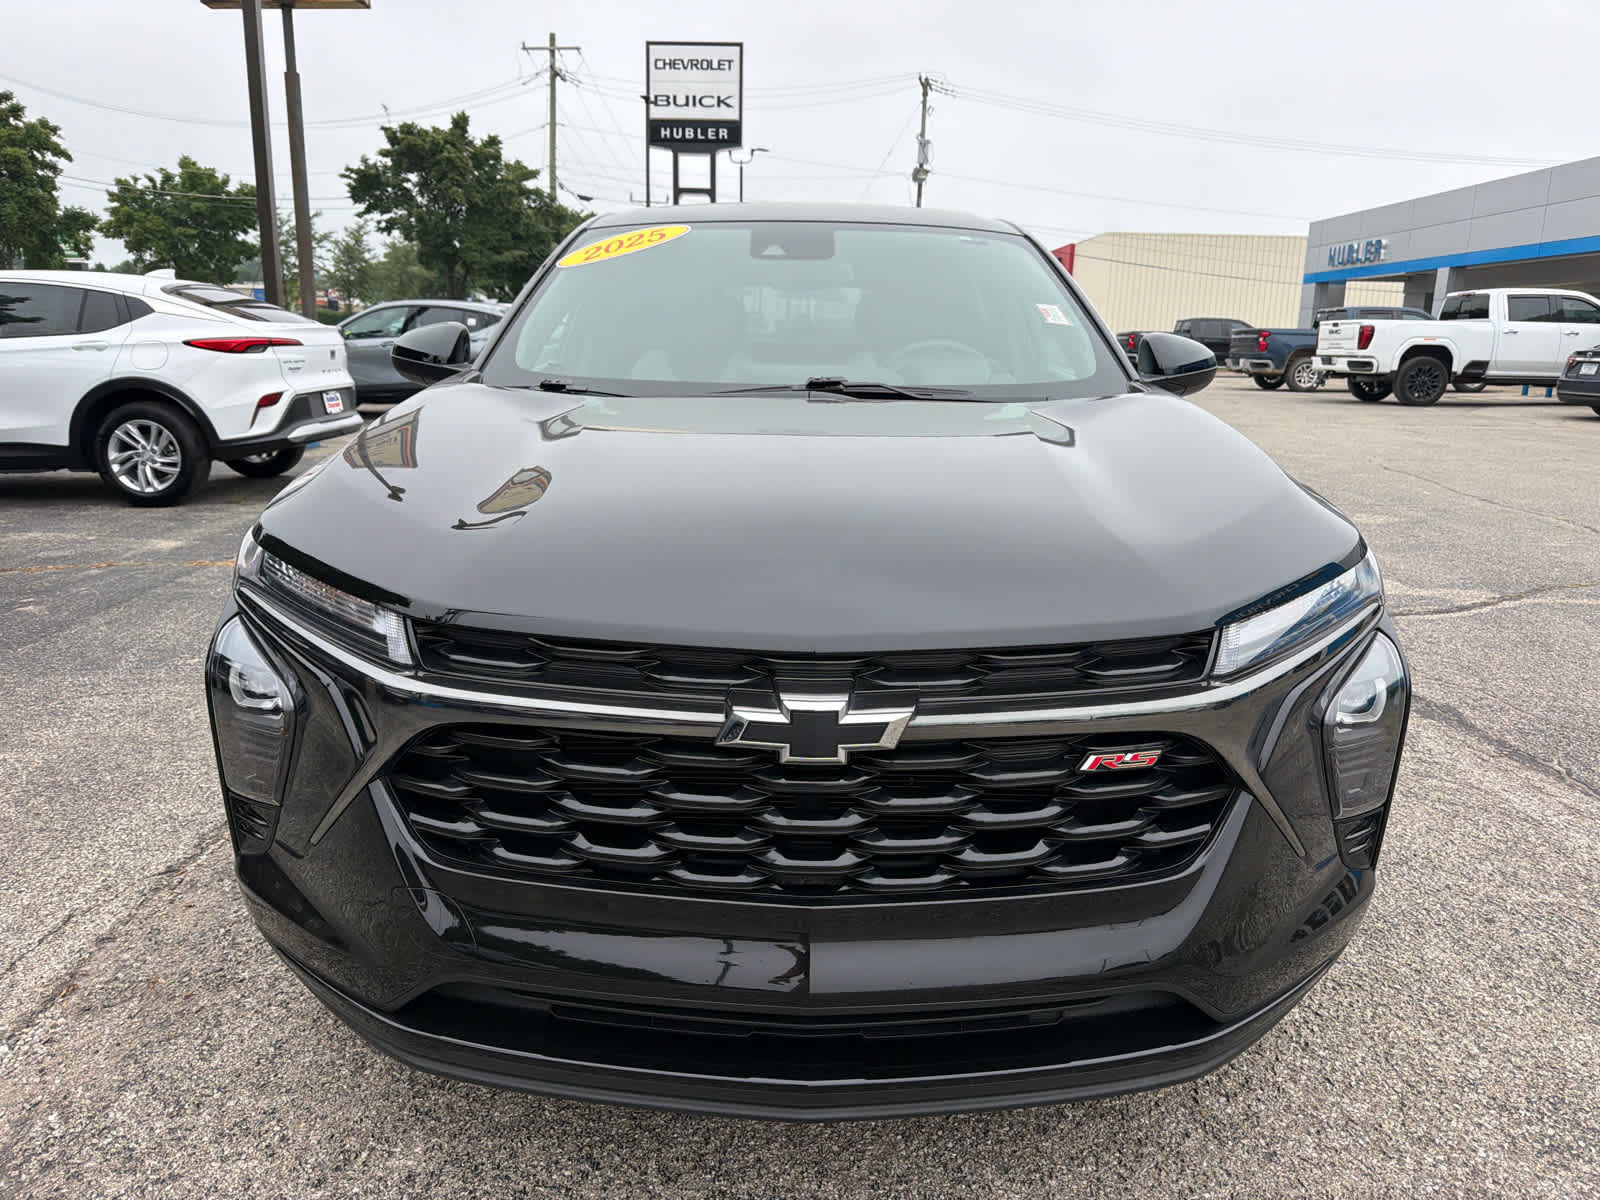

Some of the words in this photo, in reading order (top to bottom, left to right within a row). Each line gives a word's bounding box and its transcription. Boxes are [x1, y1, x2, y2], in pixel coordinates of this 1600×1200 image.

[654, 58, 734, 71] CHEVROLET
[654, 94, 734, 108] BUICK
[661, 127, 728, 139] HUBLER
[584, 228, 666, 261] 2025
[1079, 749, 1162, 771] RS
